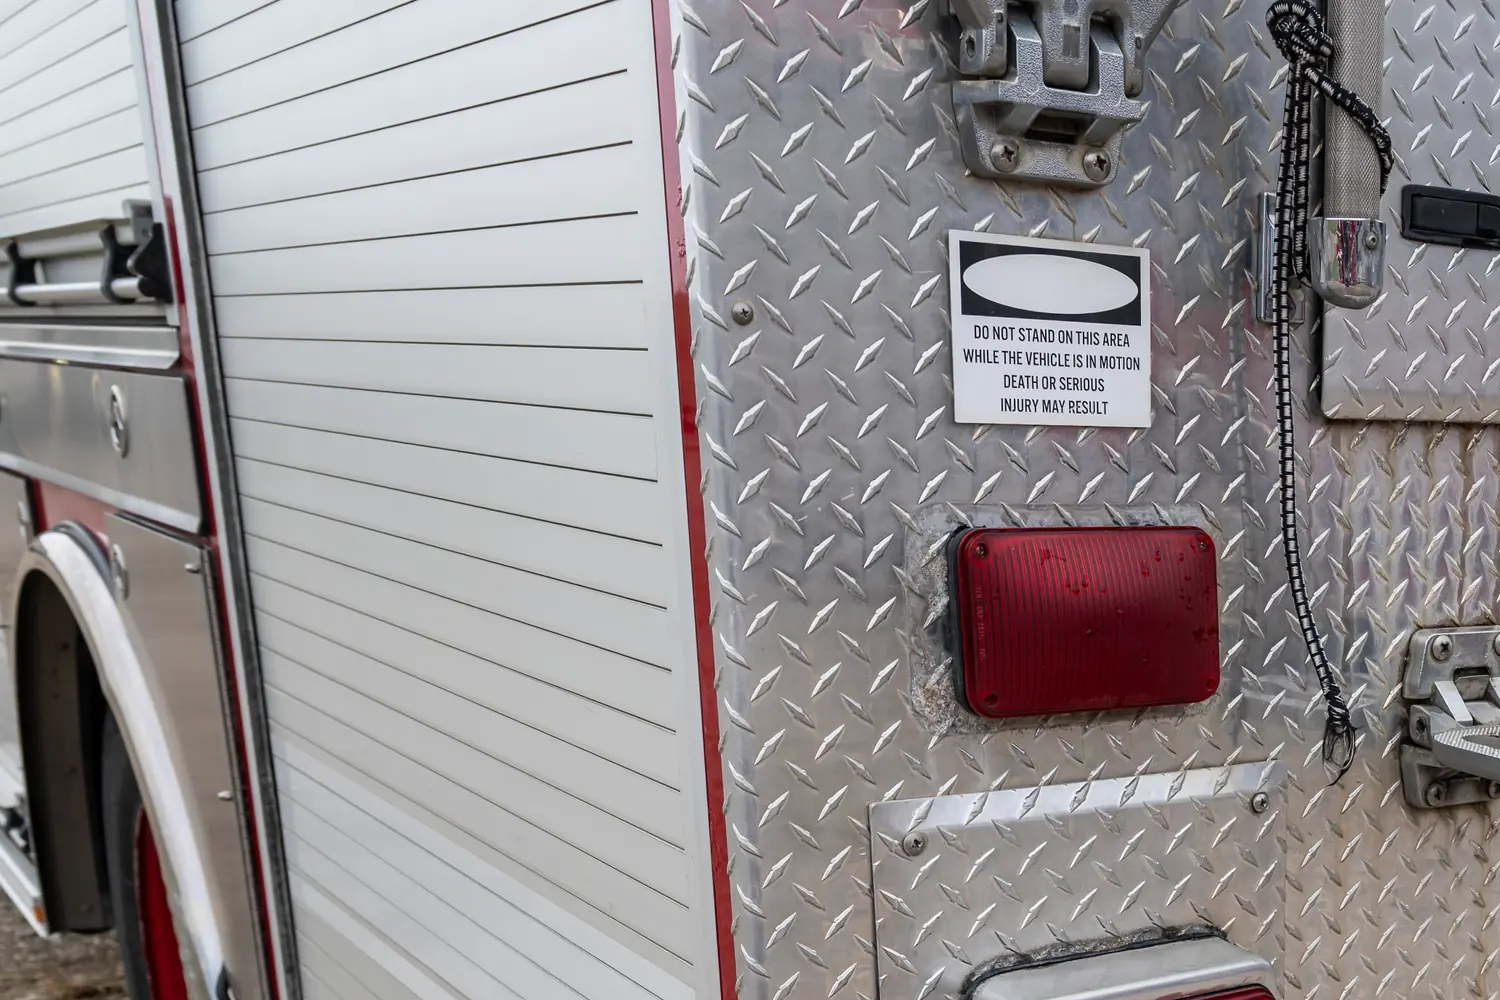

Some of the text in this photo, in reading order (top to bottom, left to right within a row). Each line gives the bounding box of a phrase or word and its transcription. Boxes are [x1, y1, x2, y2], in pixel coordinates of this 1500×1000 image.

[972, 325, 1130, 347] DO NOT STAND ON THIS AREA
[963, 348, 1140, 371] WHILE THE VEHICLE IS IN MOTION
[1003, 374, 1105, 392] DEATH OR SERIOUS
[1000, 398, 1109, 415] INJURY MAY RESULT
